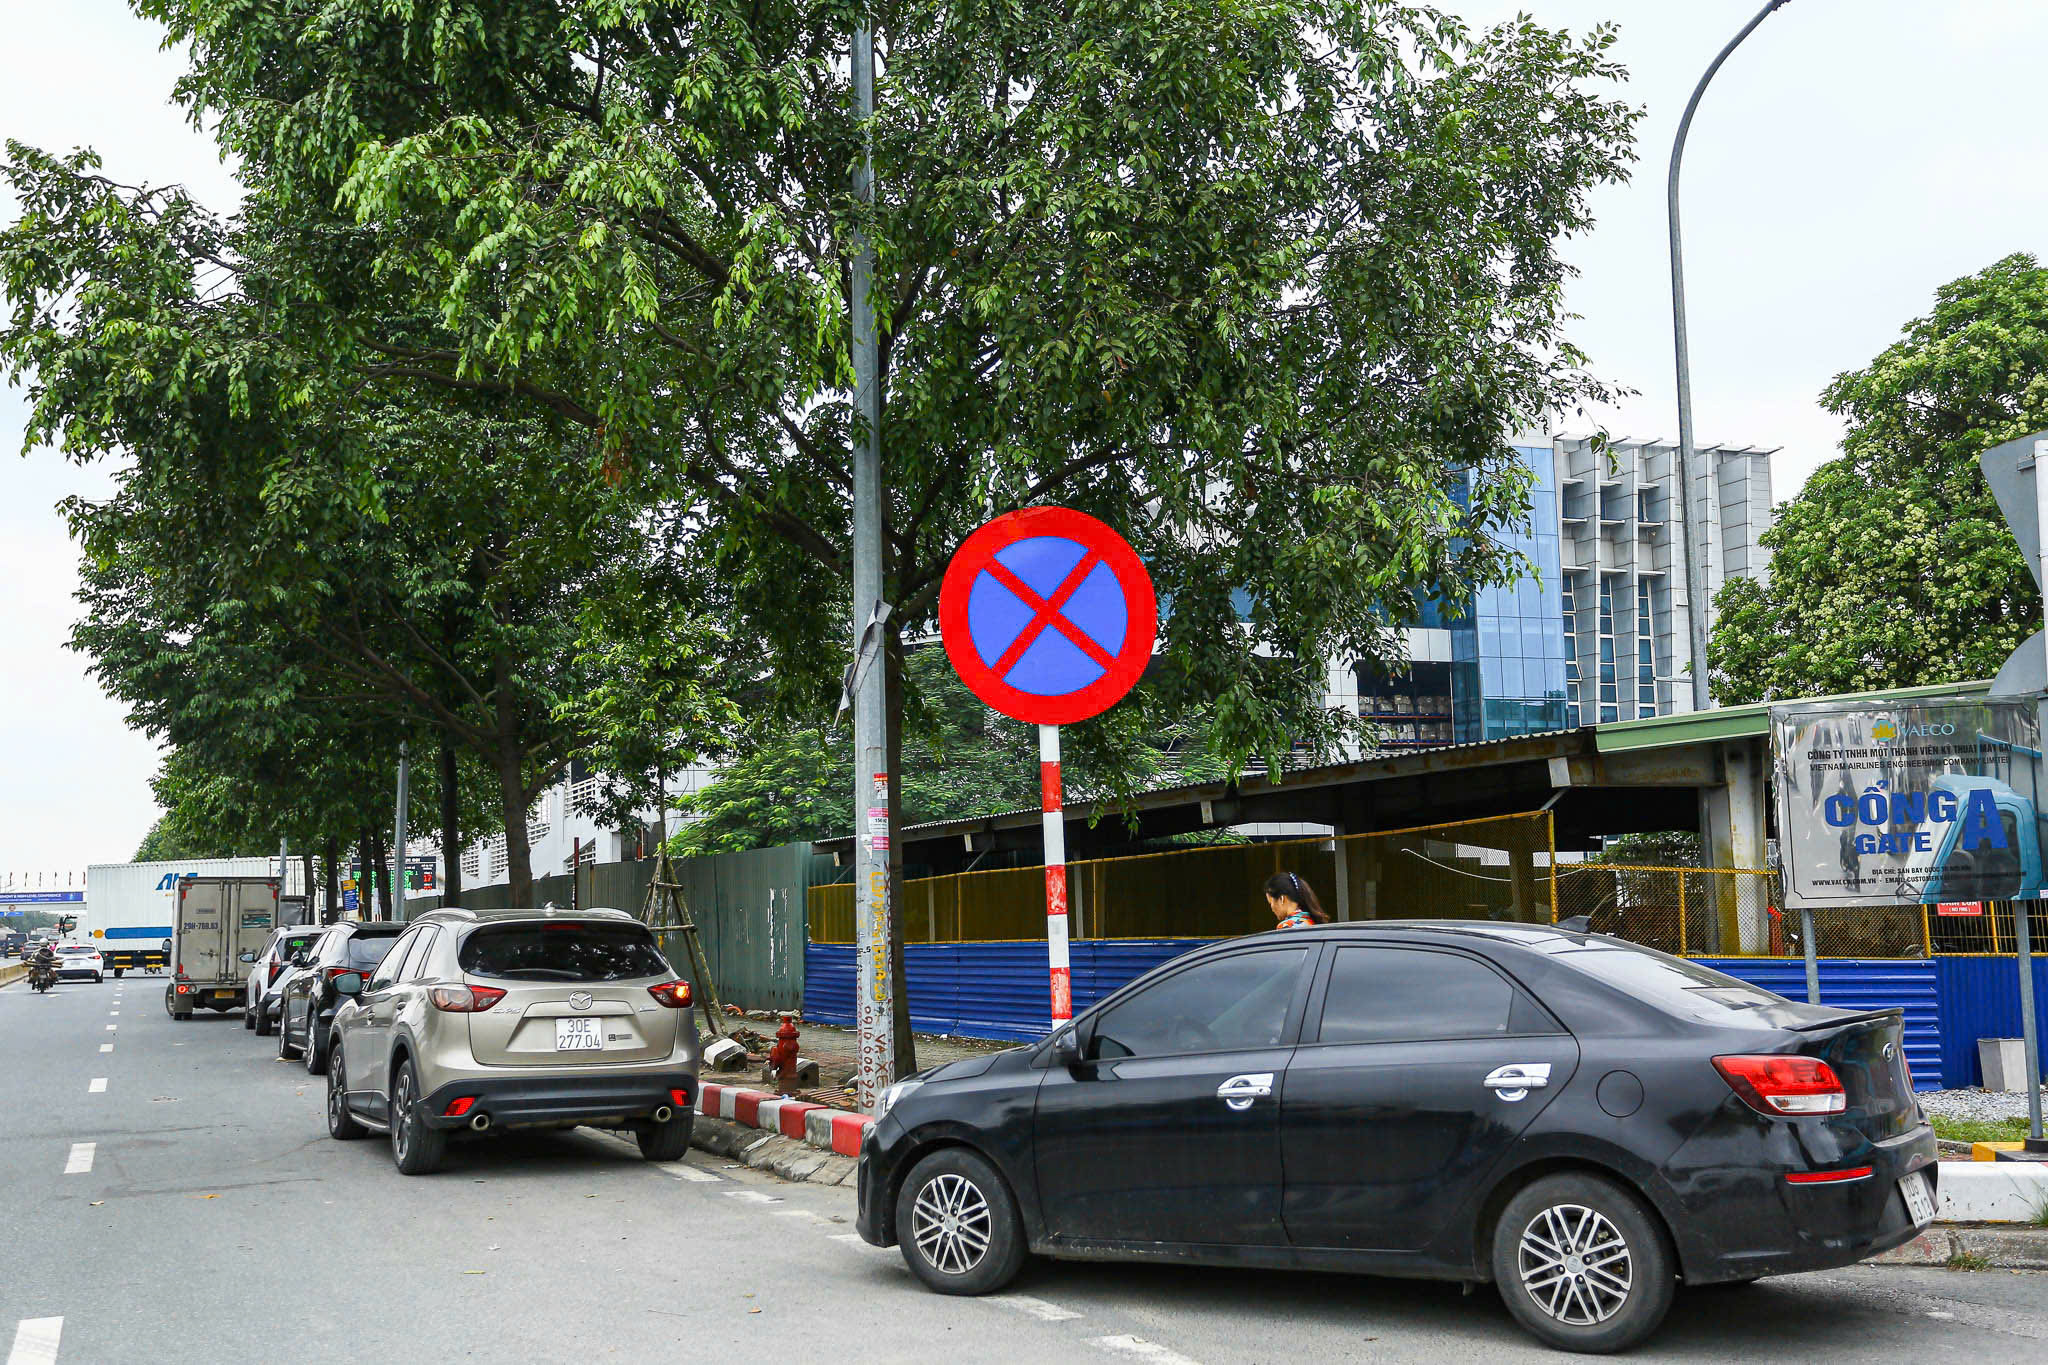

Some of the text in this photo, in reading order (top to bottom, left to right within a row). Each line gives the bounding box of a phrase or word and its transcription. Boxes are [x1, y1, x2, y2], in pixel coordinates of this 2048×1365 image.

[1900, 724, 1955, 737] VAECO
[1833, 750, 1844, 759] TY
[1845, 749, 1868, 758] TNHH
[1810, 763, 1847, 771] VIETNAM
[1848, 761, 1886, 770] AIRLINES
[1824, 780, 2009, 849] CỔNG A
[1855, 832, 1933, 855] GATE
[567, 1018, 592, 1033] 30E
[558, 1034, 601, 1049] 277.04
